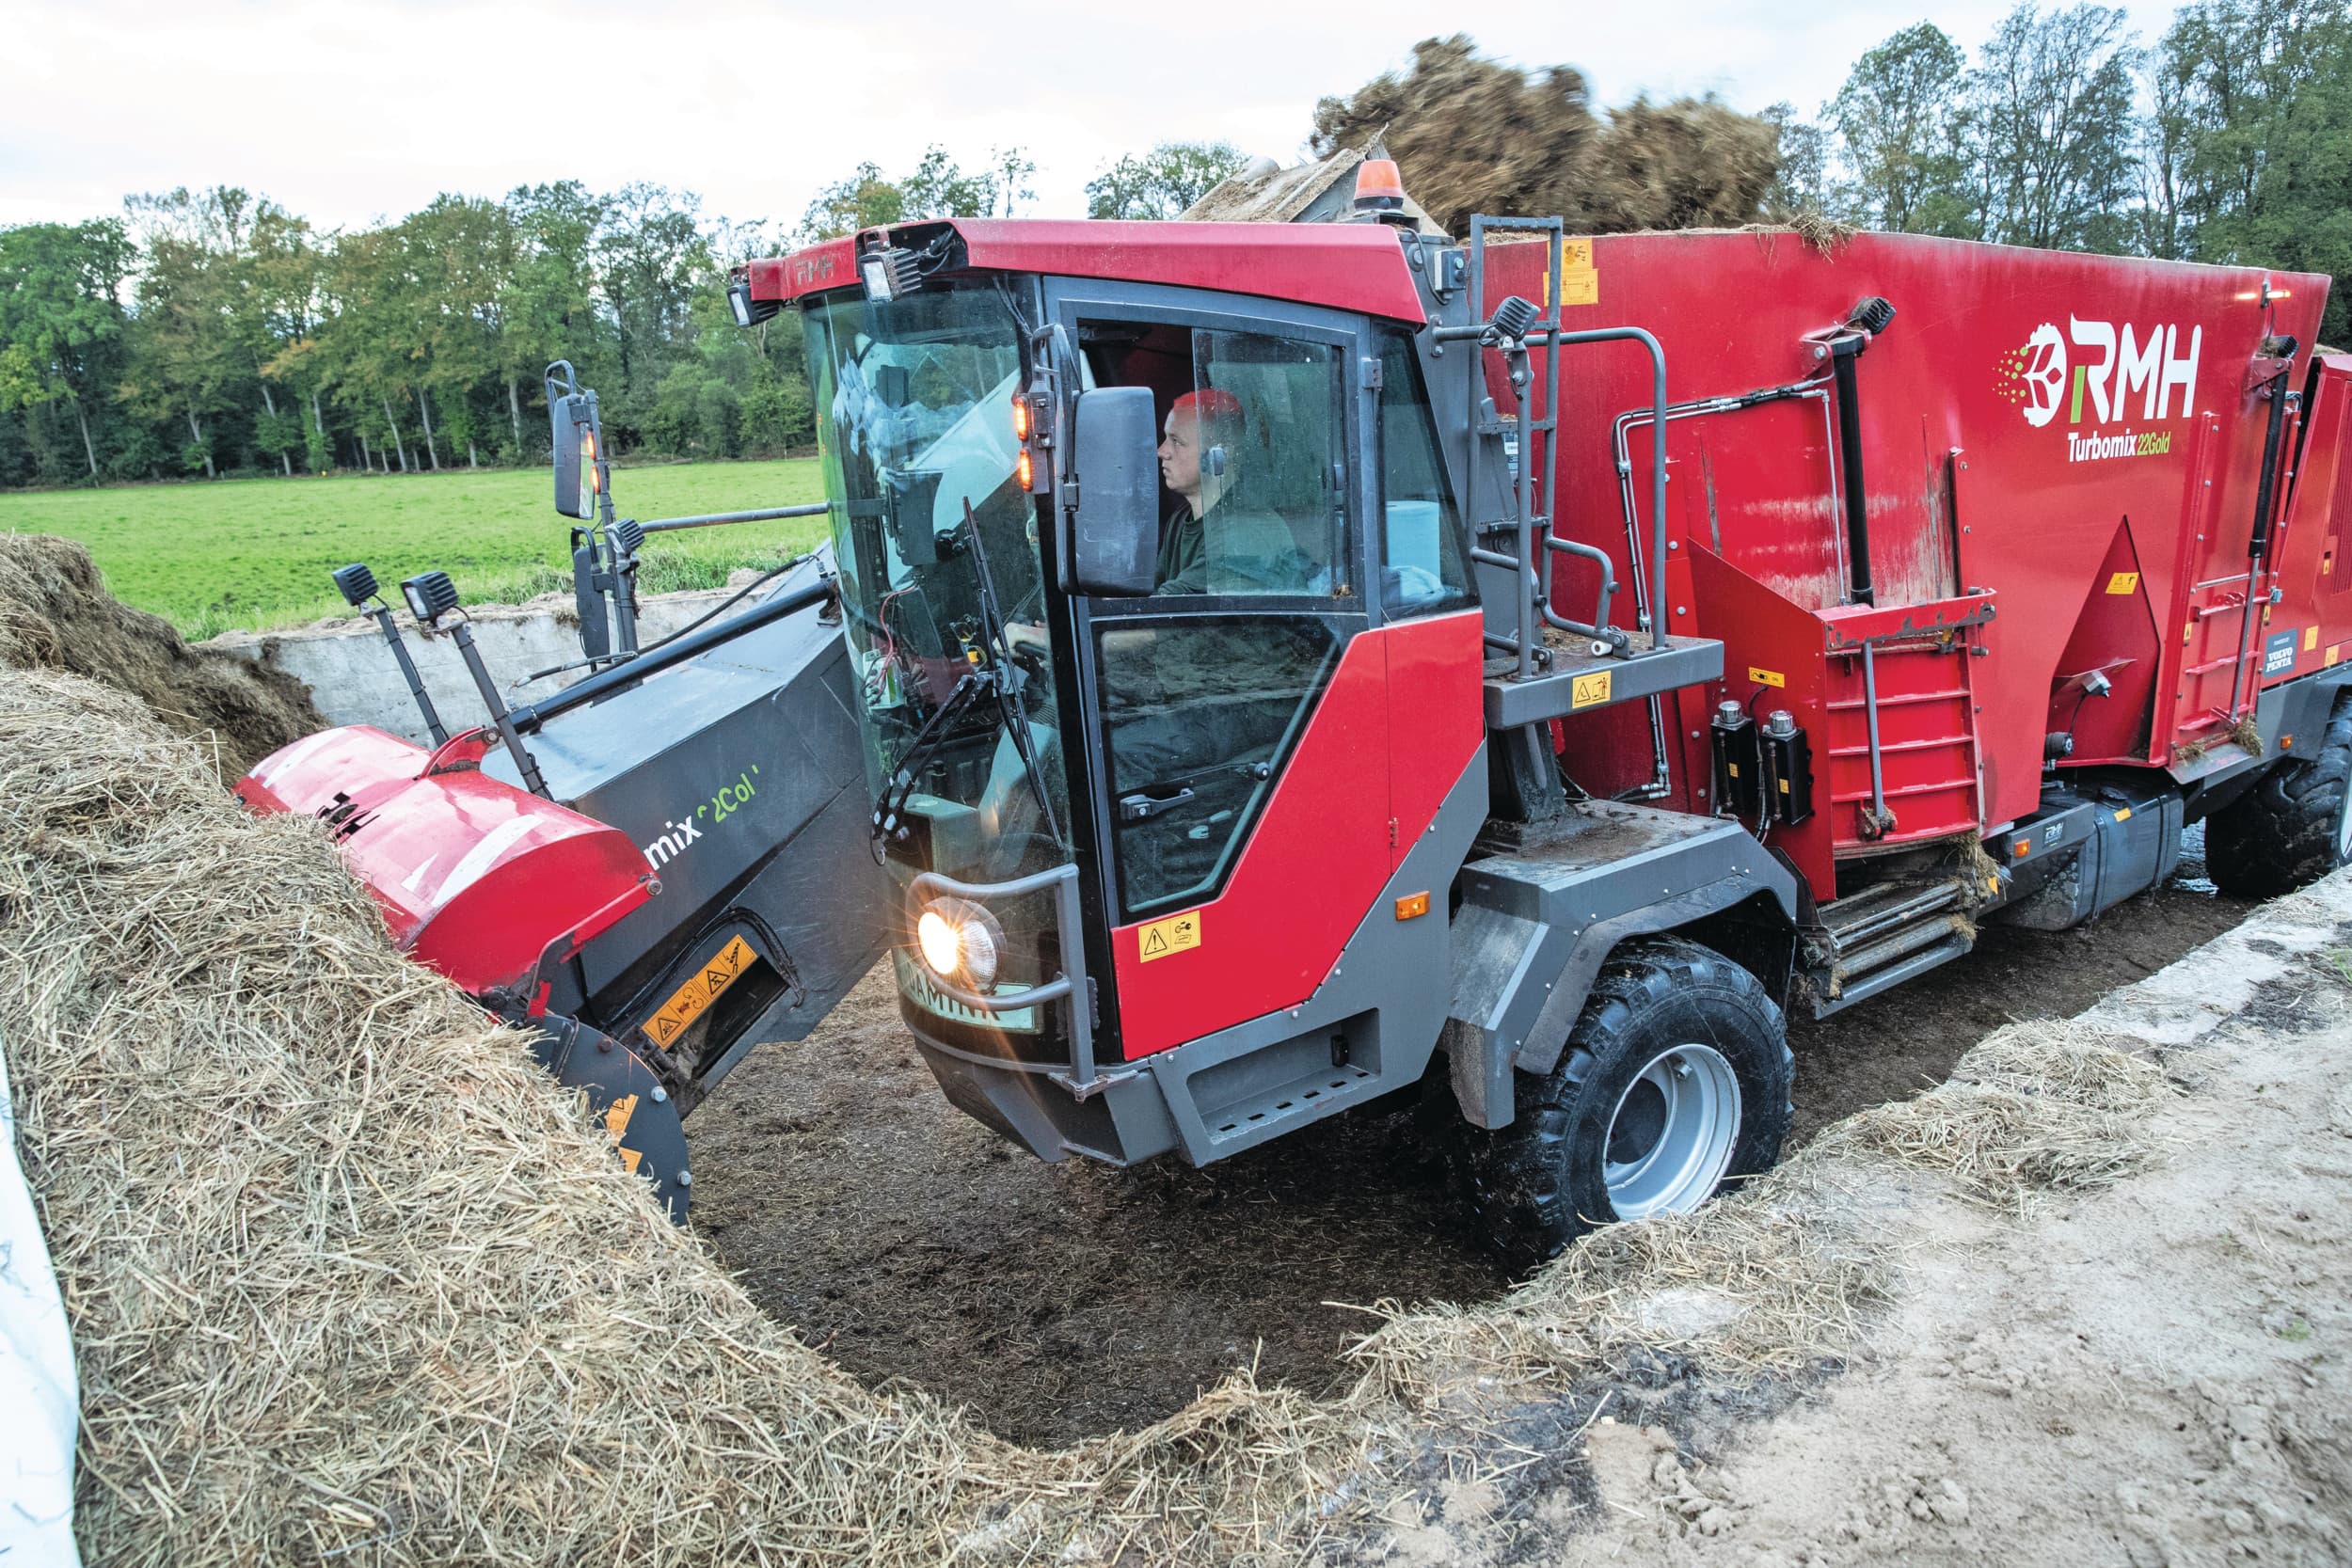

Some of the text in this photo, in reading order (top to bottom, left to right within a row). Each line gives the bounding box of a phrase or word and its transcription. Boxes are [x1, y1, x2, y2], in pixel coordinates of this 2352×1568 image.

[2070, 312, 2202, 424] RMH
[2268, 647, 2293, 661] VOLVO
[2265, 657, 2292, 673] PENTA
